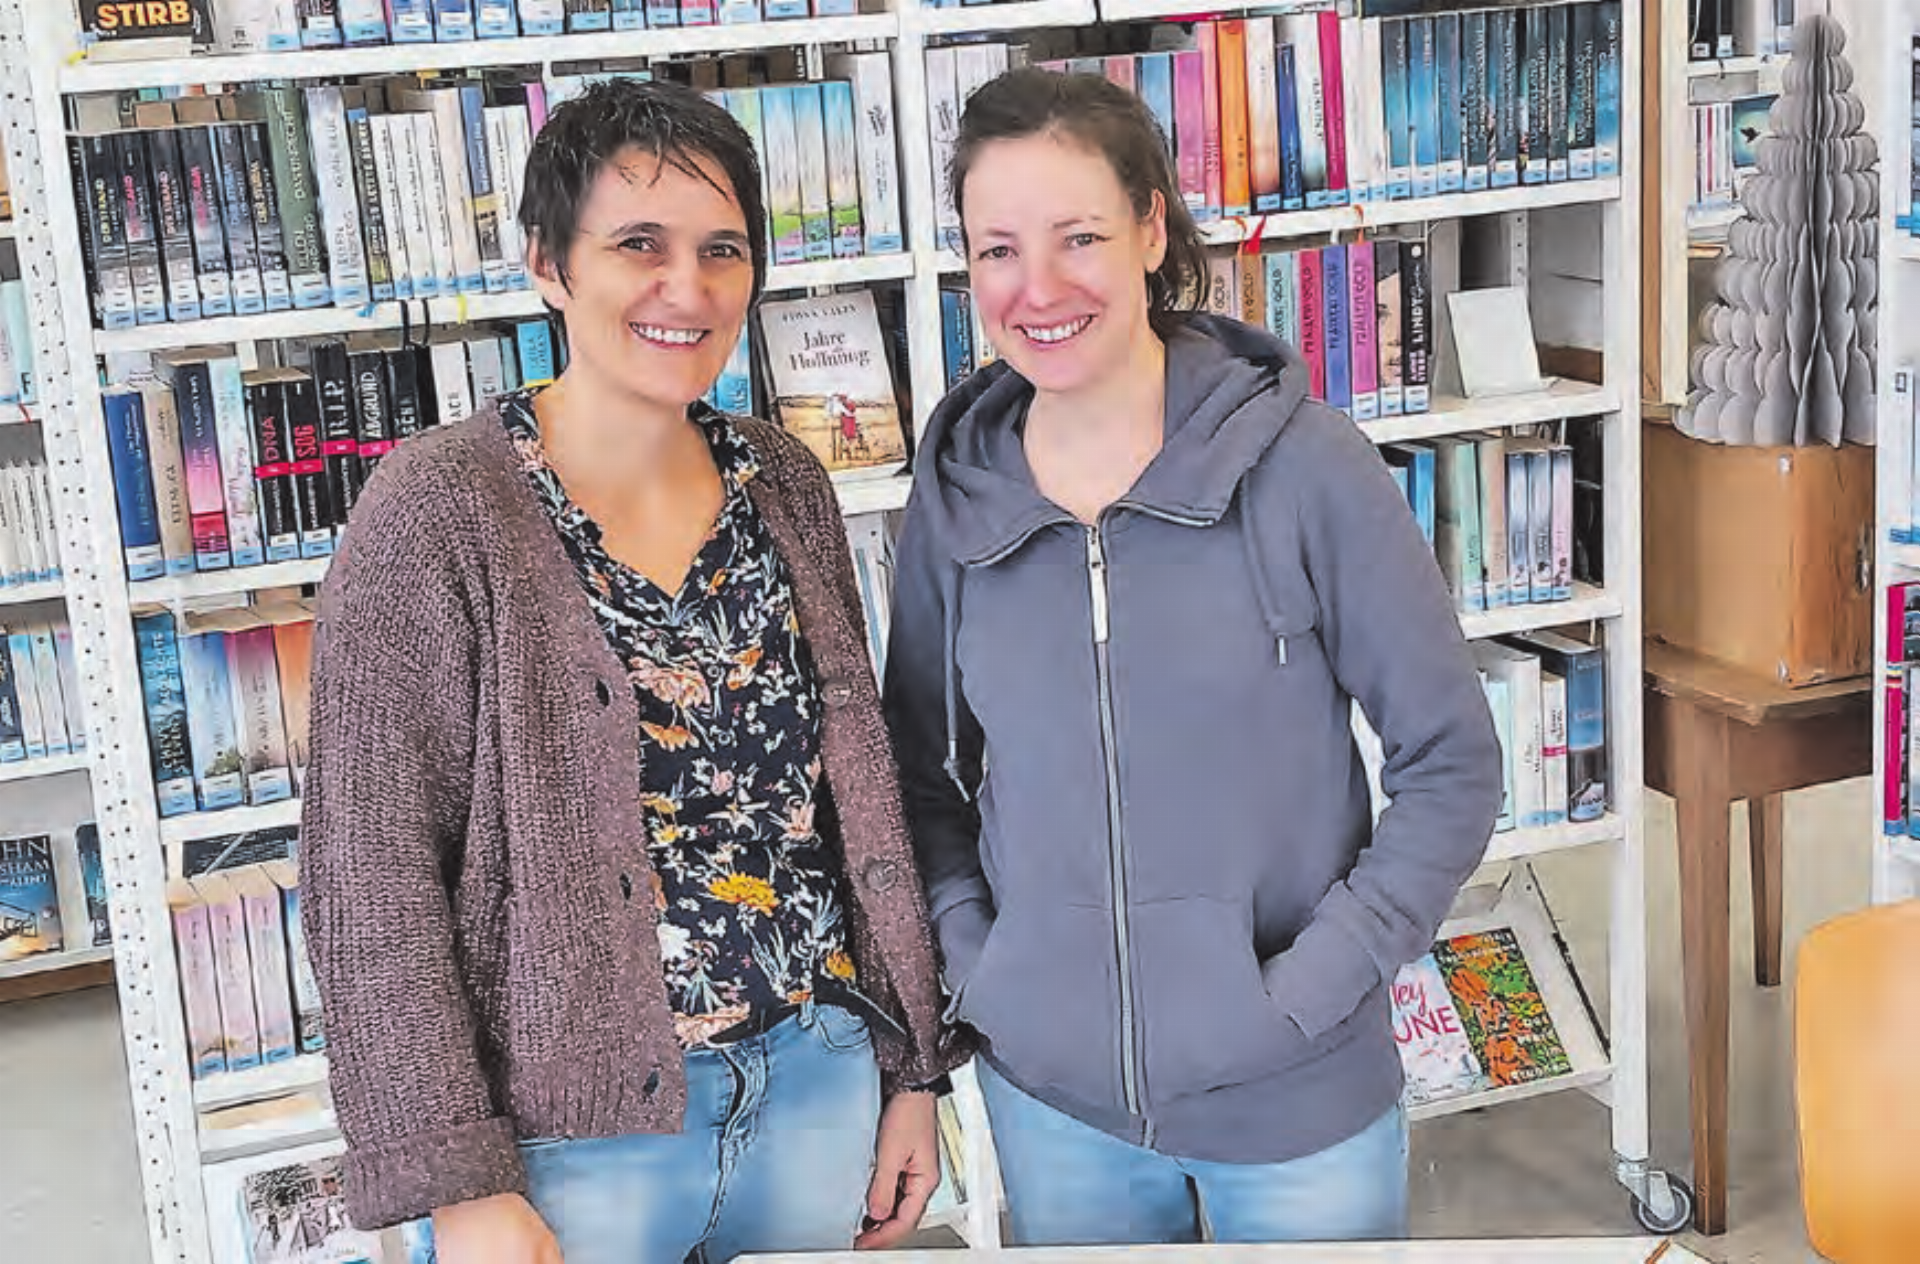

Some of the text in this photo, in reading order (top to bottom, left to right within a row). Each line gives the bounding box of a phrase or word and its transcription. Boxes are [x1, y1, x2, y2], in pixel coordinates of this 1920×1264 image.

[98, 1, 191, 29] STIRB
[1213, 276, 1226, 309] GOLD
[1243, 271, 1255, 306] GOLD
[1271, 267, 1284, 302] GOLD
[1302, 265, 1314, 299] GOLD
[1326, 262, 1339, 296] GOLD
[1353, 259, 1366, 292] GOLD
[1410, 297, 1426, 343] LINDY
[804, 331, 847, 351] Jahre
[790, 349, 872, 371] Hoffnung
[360, 371, 383, 438] ABGRUND
[263, 416, 279, 460] DNA
[294, 424, 316, 457] SOG
[157, 724, 173, 769] CHEVY
[170, 713, 186, 772] STEVENS
